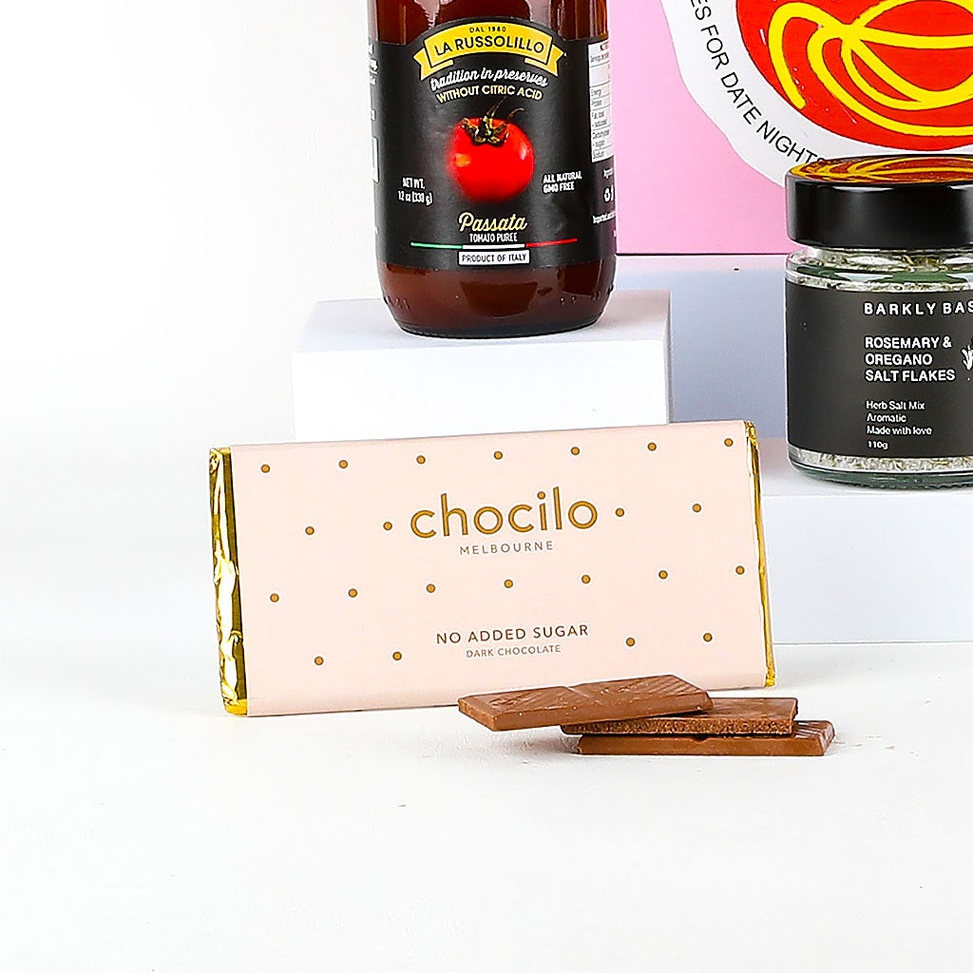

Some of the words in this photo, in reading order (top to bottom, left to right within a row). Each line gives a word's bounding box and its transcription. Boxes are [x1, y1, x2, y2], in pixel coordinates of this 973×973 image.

[434, 42, 453, 56] LA
[455, 35, 544, 53] RUSSOLILLO
[430, 68, 480, 91] tradition
[481, 67, 494, 80] in
[493, 68, 548, 87] preserves
[436, 85, 480, 103] WITHOUT
[481, 85, 515, 95] CITRIC
[517, 87, 543, 101] ACID
[701, 25, 730, 70] FOR
[721, 72, 762, 125] DATE
[756, 120, 825, 164] NIGHT
[543, 174, 556, 184] ALL
[556, 170, 583, 182] NATURAL
[543, 183, 559, 194] GMO
[559, 181, 575, 191] FREE
[459, 212, 528, 232] Passata
[469, 233, 496, 243] TOMATO
[496, 232, 518, 242] PUREE
[462, 254, 495, 262] PRODUCT
[497, 254, 507, 262] OF
[508, 253, 527, 262] ITALY
[864, 302, 936, 315] BARKLY
[864, 336, 940, 349] ROSEMARY
[942, 336, 952, 348] &
[865, 353, 933, 366] OREGANO
[865, 370, 899, 382] SALT
[902, 369, 956, 382] FLAKES
[866, 400, 888, 410] Herb
[888, 400, 907, 410] Salt
[908, 400, 926, 410] Mix
[866, 412, 907, 422] Aromatic
[866, 425, 891, 435] Made
[892, 425, 912, 435] with
[912, 426, 933, 435] love
[868, 440, 889, 450] 110g
[410, 486, 598, 539] chocilo
[459, 540, 553, 555] MELBOURNE
[436, 632, 461, 644] NO
[467, 628, 526, 643] ADDED
[533, 624, 589, 639] SUGAR
[466, 647, 494, 658] DARK
[497, 644, 561, 657] CHOCOLATE
